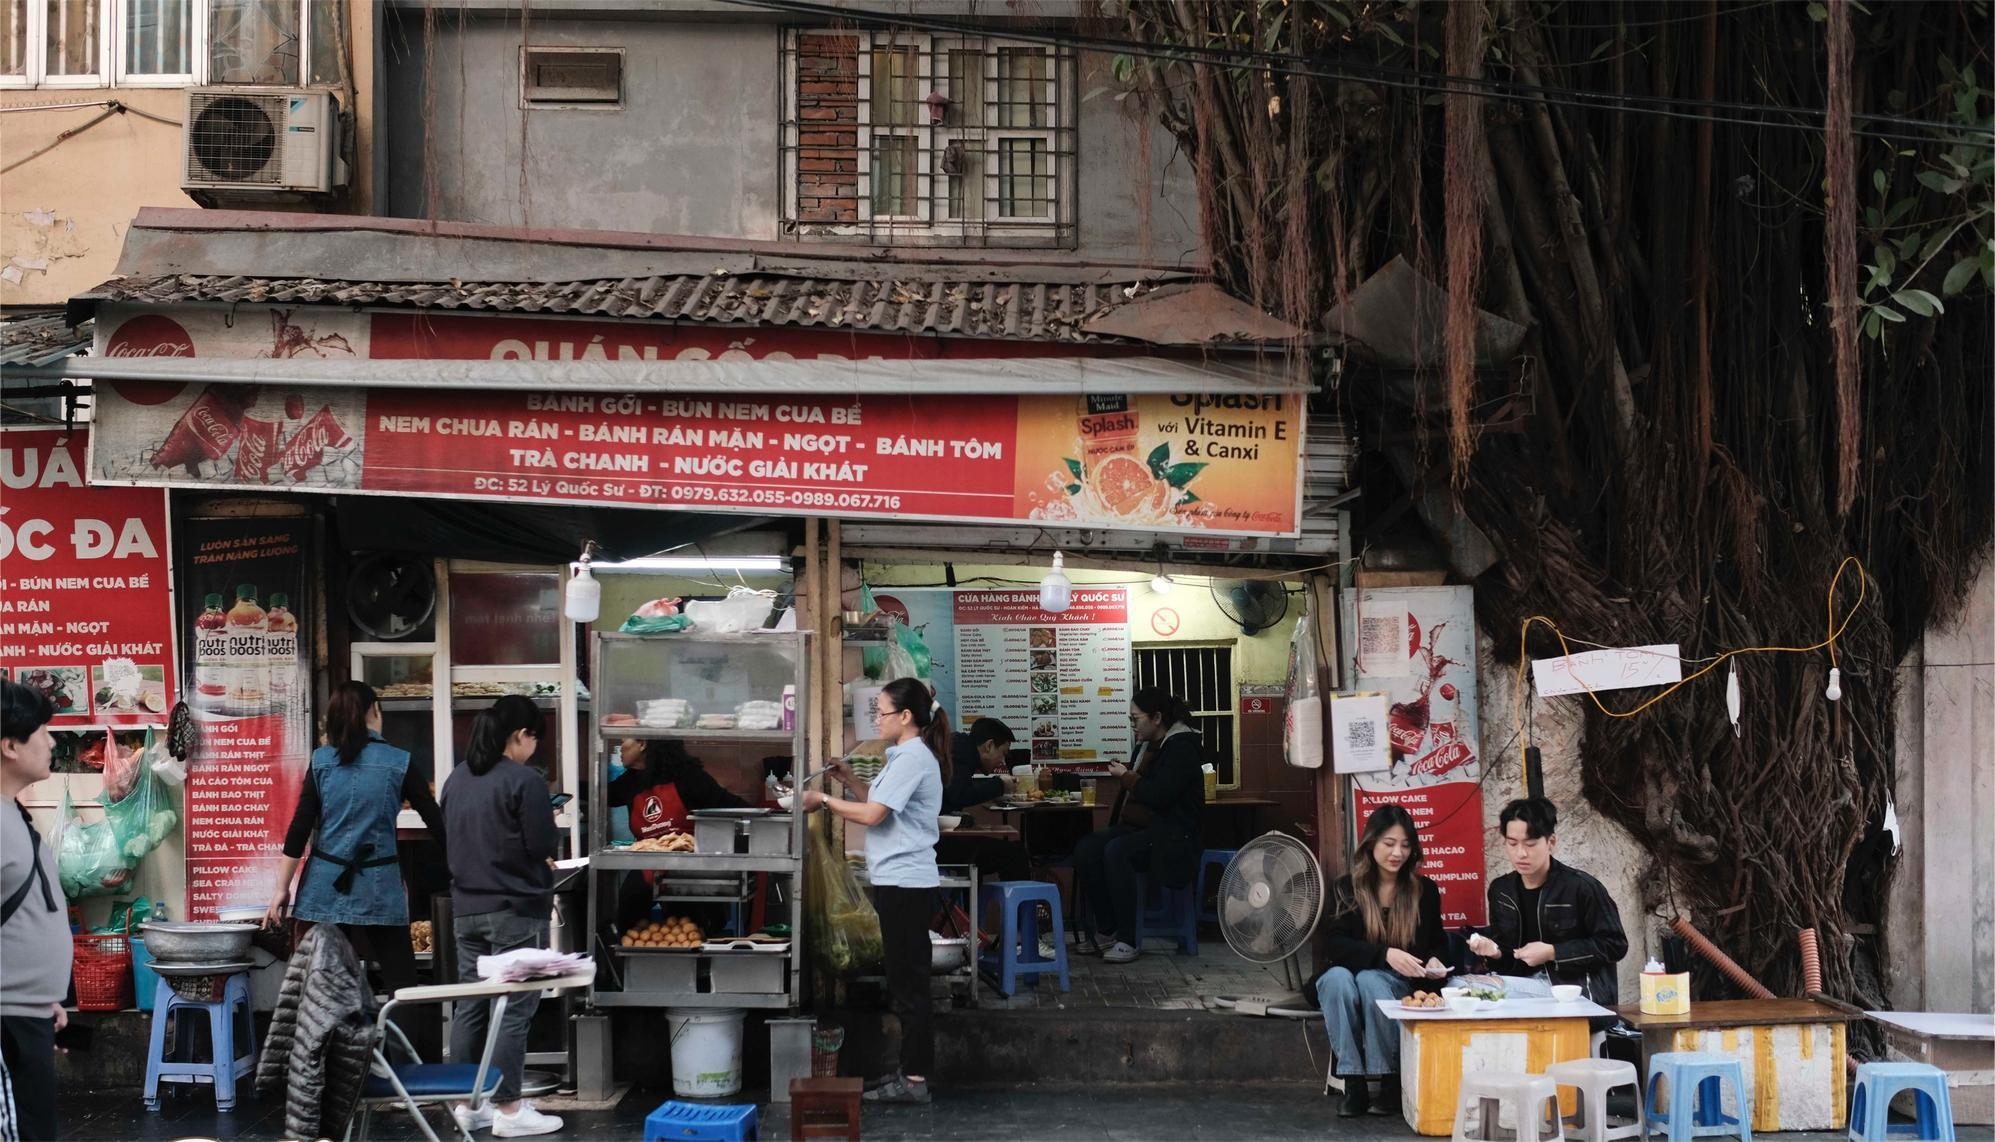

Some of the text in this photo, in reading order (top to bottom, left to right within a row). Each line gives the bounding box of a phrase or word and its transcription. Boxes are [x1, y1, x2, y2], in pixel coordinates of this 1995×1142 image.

[718, 403, 770, 421] NEM
[775, 404, 825, 424] CUA
[1081, 414, 1136, 437] Splash
[1157, 417, 1288, 441] với Vitamin E
[379, 415, 431, 434] NEM
[436, 417, 503, 438] CHUA
[508, 419, 559, 440] RÁN
[579, 421, 647, 444] BÁNH
[652, 424, 703, 447] RÁN
[709, 427, 764, 451] MẶN
[784, 432, 852, 456] NGỌT
[876, 434, 944, 457] BÁNH
[950, 437, 1002, 460] TÔM
[1184, 440, 1260, 461] & Canxi
[510, 447, 558, 469] TRÀ
[563, 451, 649, 473] CHANH
[674, 454, 744, 476] NƯỚC
[749, 456, 798, 479] GIẢI
[803, 460, 868, 482] KHÁT
[474, 477, 901, 509] ĐC: 52 Lý Quốc Sư ĐT: 0979.632.055-0989.067.716
[70, 518, 158, 560] ĐA
[20, 575, 52, 590] BÚN
[56, 577, 90, 590] NEM
[92, 576, 126, 590] CUA
[981, 593, 1011, 603] HÀNG
[17, 597, 50, 613] RÁN
[18, 620, 54, 637] MẶN
[66, 621, 110, 636] NGỌT
[199, 638, 226, 648] nutr
[229, 635, 266, 646] nutri
[38, 640, 163, 657] NƯỚC GIẢI KHÁT
[200, 647, 226, 656] boos
[229, 646, 267, 656] boost
[213, 737, 235, 746] NEM
[236, 737, 257, 746] CUA
[220, 749, 241, 759] RÁN
[221, 763, 242, 773] RÁN
[253, 777, 274, 786] CUA
[192, 789, 219, 799] BÁNH
[221, 790, 242, 799] BAO
[1362, 794, 1428, 804] PILLOW CAKE
[192, 802, 270, 812] BÁNH BAO CHAY
[1413, 807, 1434, 816] NEM
[192, 815, 265, 826] NEM CHUA RÁN
[243, 828, 270, 838] KHÁT
[192, 842, 213, 852] TRÀ
[214, 841, 229, 851] ĐÁ
[257, 842, 285, 851] CHAN
[1431, 846, 1466, 855] HACAO
[193, 865, 257, 875] PILLOW CAKE
[1429, 872, 1479, 881] DUMPLING
[193, 879, 213, 888] SEA
[193, 892, 223, 901] SALTY
[1447, 912, 1467, 921] TEA
